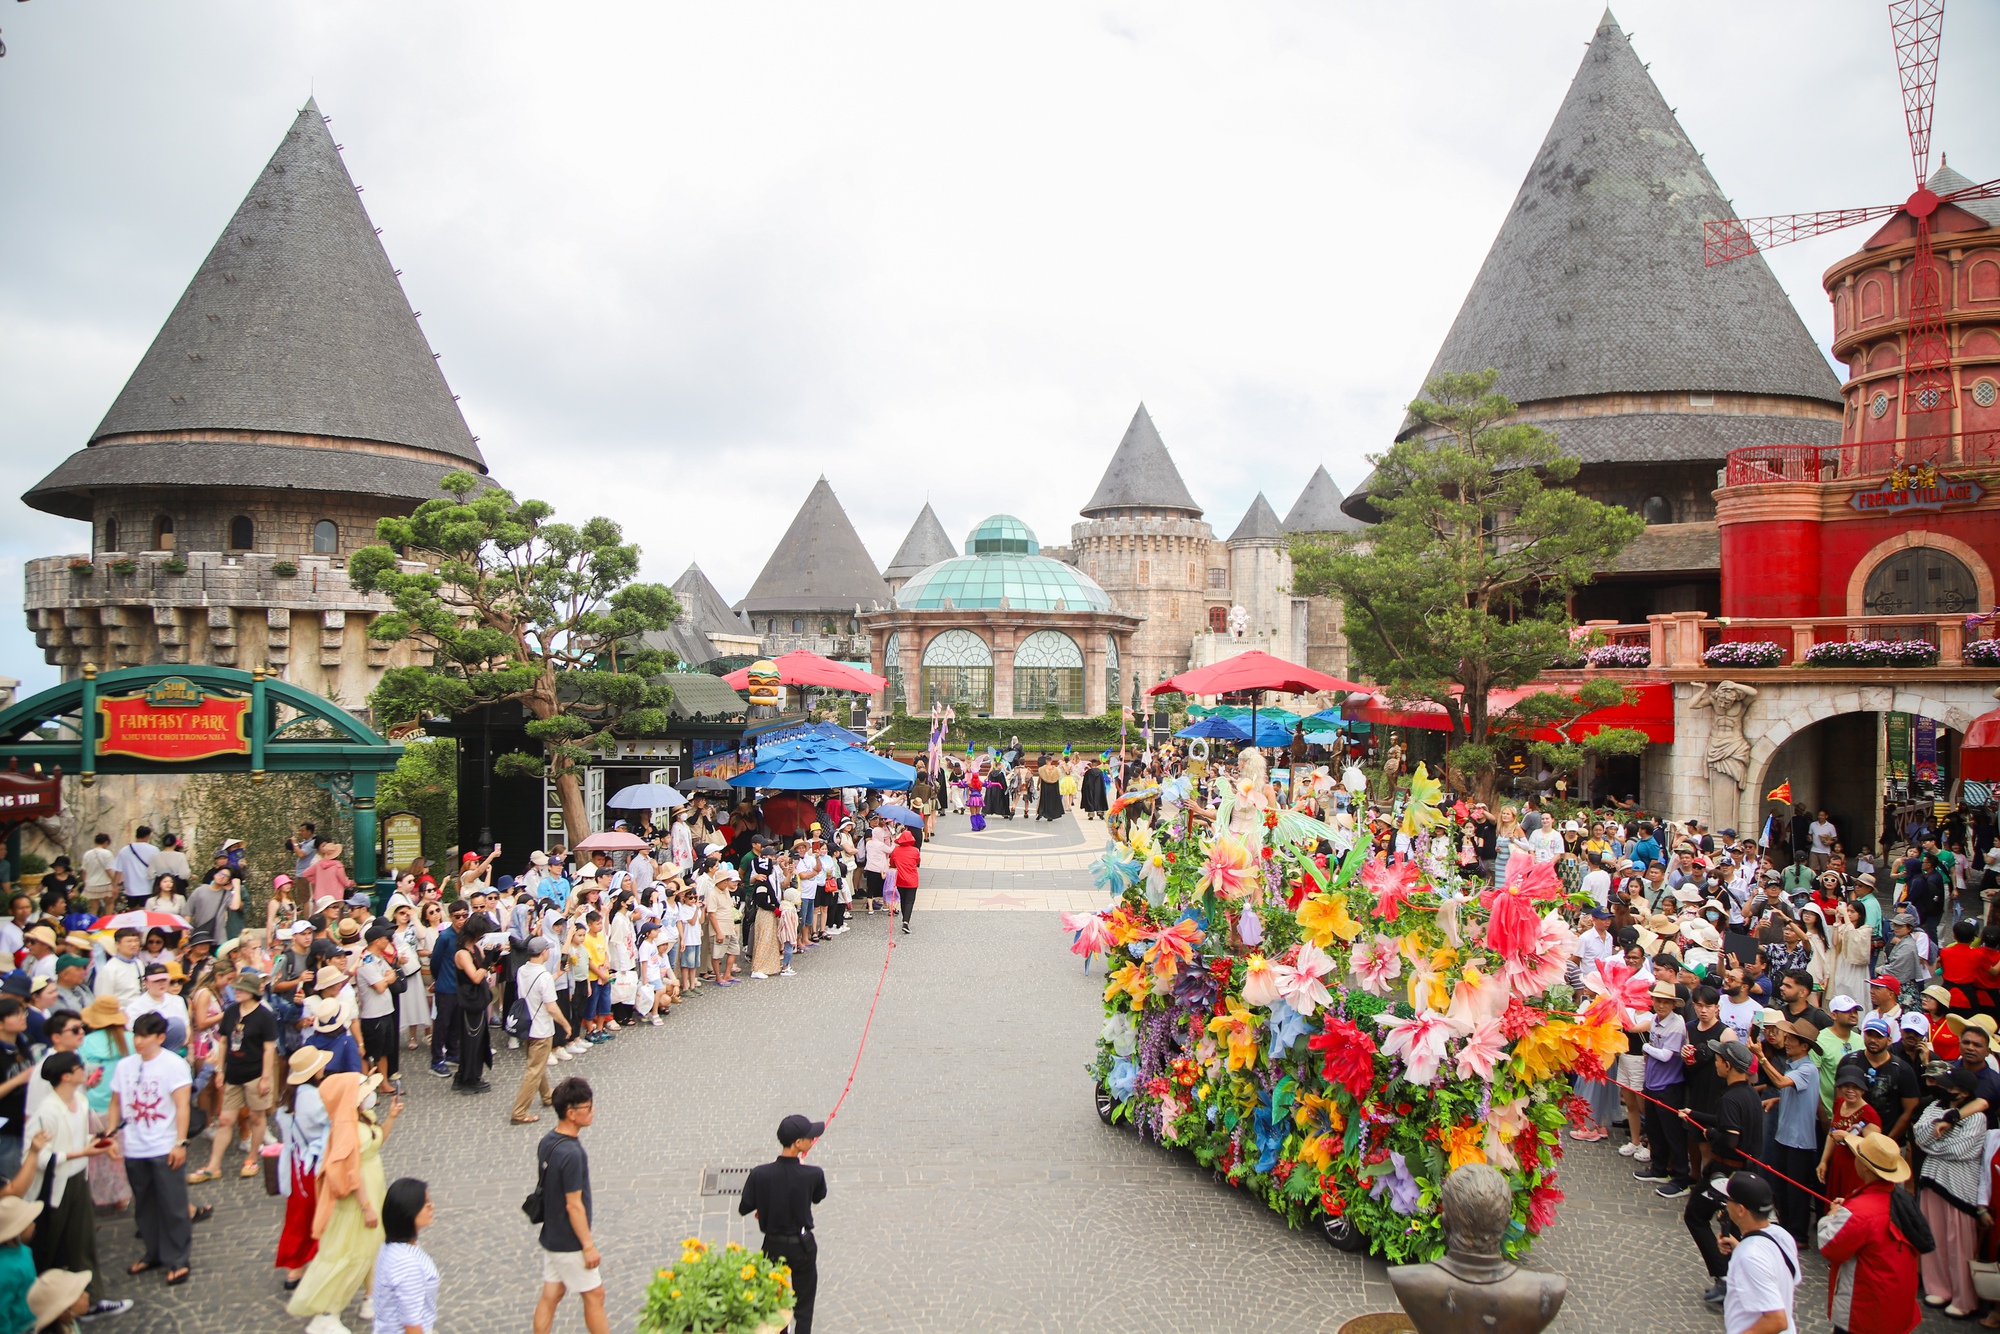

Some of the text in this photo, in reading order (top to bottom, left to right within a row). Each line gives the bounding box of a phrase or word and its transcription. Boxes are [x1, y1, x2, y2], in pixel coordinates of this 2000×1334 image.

[1860, 484, 1972, 508] FRENCH VILLAGE
[164, 682, 186, 690] SUN
[155, 690, 195, 700] WORLD
[119, 713, 229, 731] FANTASY PARK
[18, 793, 40, 805] TIN
